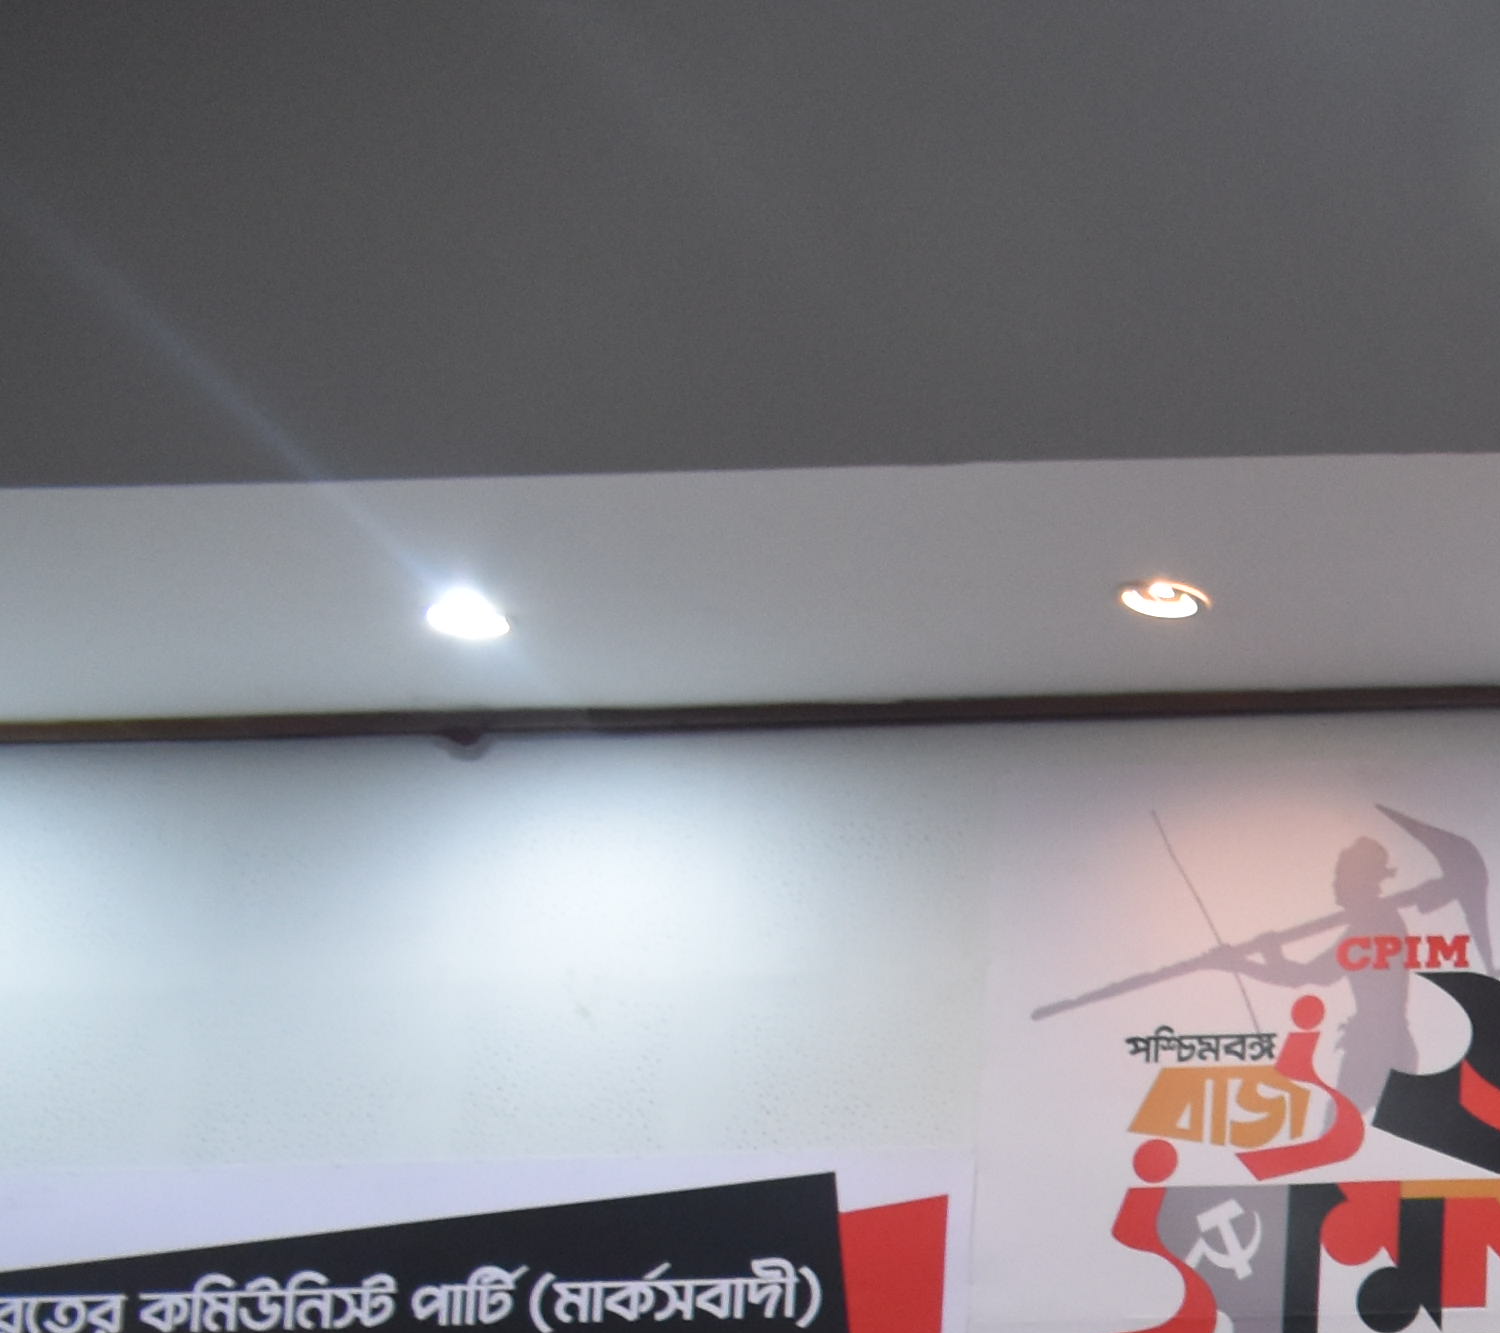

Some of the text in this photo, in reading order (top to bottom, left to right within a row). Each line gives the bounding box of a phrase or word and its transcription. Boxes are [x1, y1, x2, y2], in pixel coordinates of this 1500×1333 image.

[1336, 935, 1470, 970] CPIM
[1126, 1025, 1277, 1063] পশ্চিমবঙ্গ
[139, 1270, 398, 1333] কমিউনিস্ট
[412, 1265, 529, 1326] পার্টি
[530, 1257, 821, 1333] (মার্কসবাদী)
